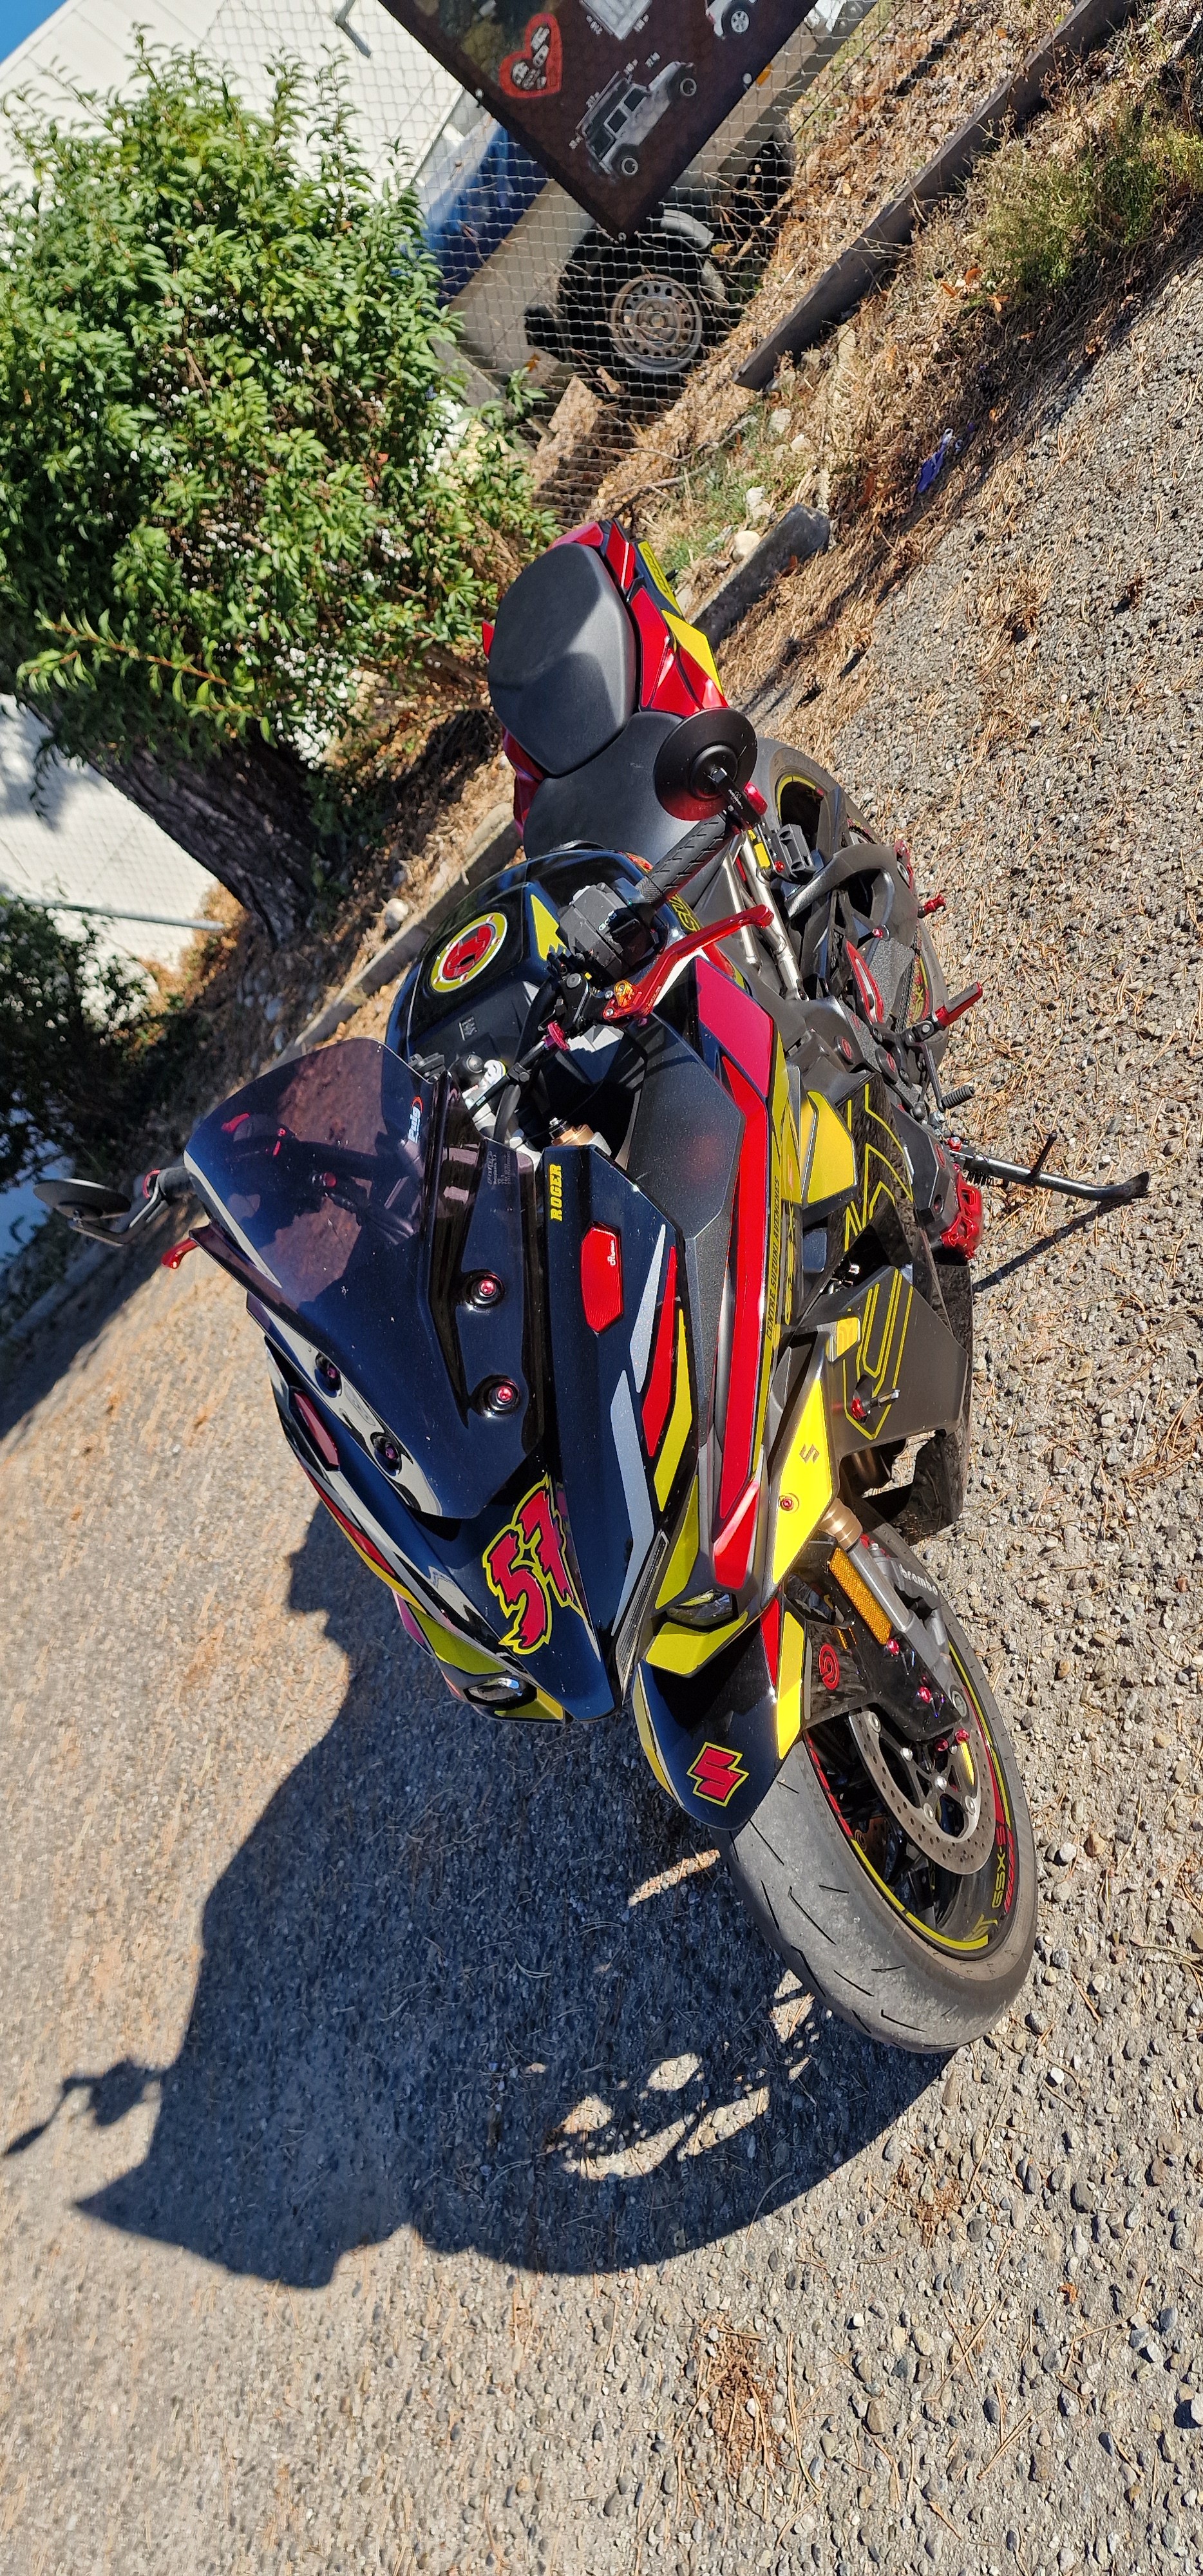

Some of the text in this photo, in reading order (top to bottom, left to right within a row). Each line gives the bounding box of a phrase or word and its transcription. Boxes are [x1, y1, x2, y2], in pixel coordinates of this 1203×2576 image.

[549, 1164, 563, 1222] ROGER
[766, 1289, 776, 1341] CENTRE
[484, 1474, 582, 1654] 57
[898, 1564, 939, 1596] brembo
[992, 1826, 1007, 1908] GSX-S
